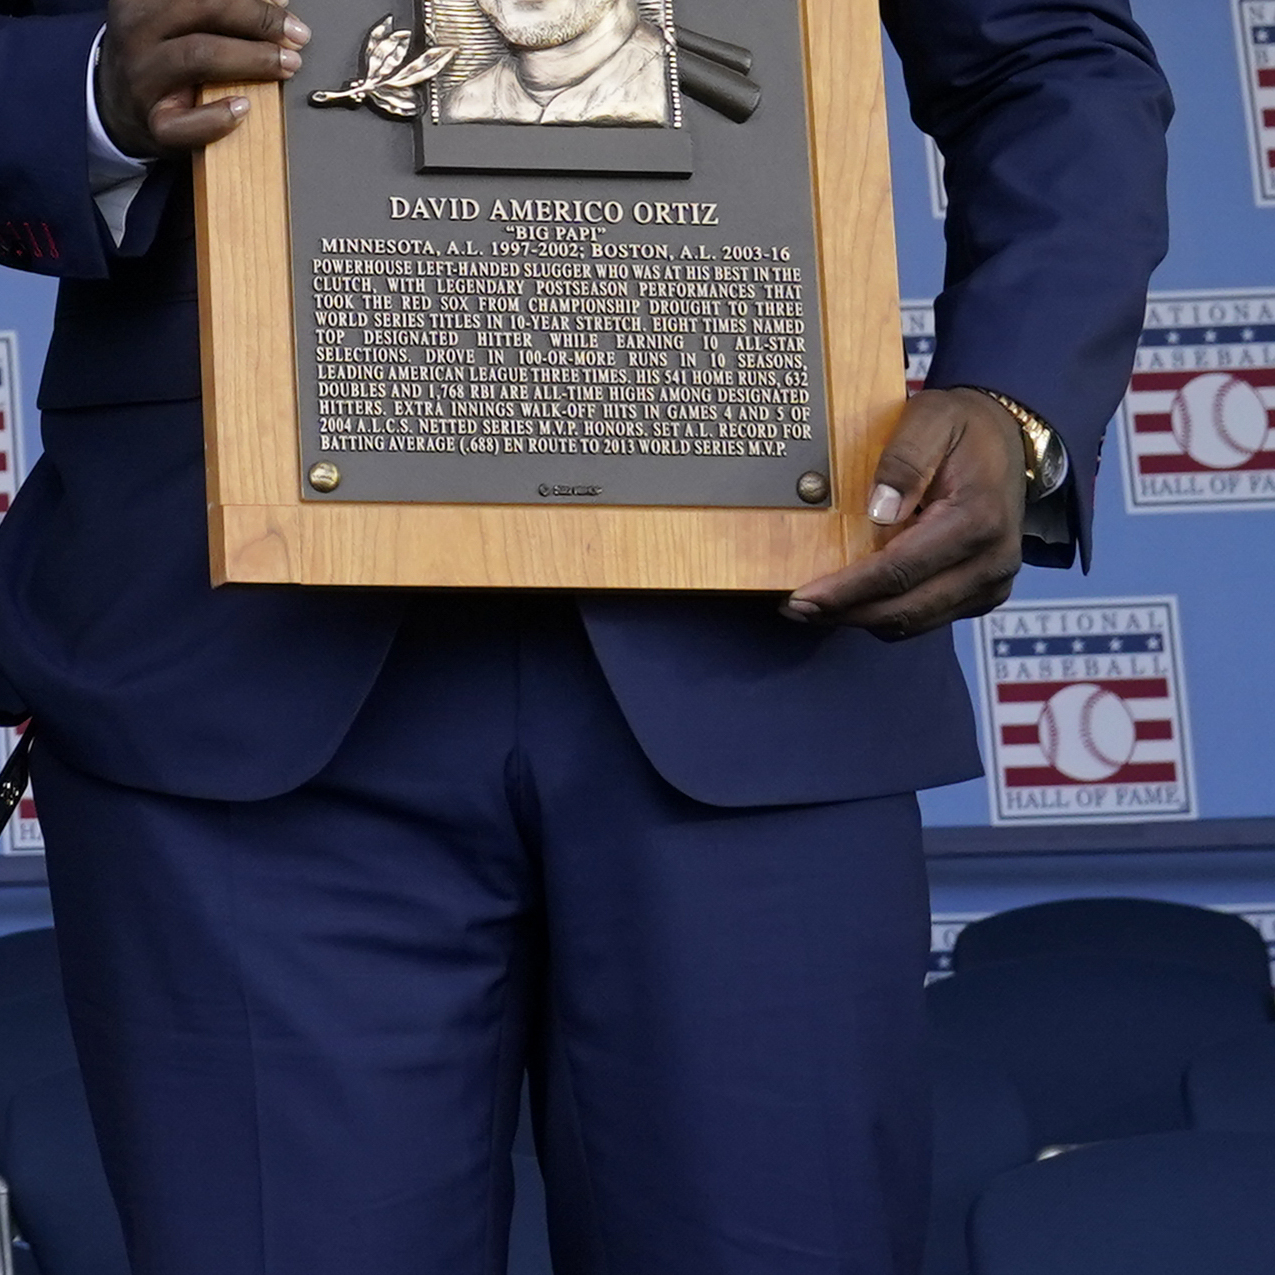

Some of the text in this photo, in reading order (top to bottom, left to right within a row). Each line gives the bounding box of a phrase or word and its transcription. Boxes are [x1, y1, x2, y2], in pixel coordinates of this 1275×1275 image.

[389, 196, 719, 224] DAVID AMERICO ORTIZ
[555, 225, 606, 242] PAPI”
[321, 237, 790, 261] MINNESOTA, A.L. 1997-2002; BOSTON, A.L. 2003-16
[313, 258, 801, 282] POWERHOUSE LEFT-HANDED SLUGGER WHO WAS AT HIS BEST IN THE
[313, 275, 803, 299] CLUTCH, WITH LEGENDARY POSTSEASON PERFORMANCES THAT
[314, 293, 804, 317] TOOK THE RED SOX FROM CHAMPIONSHIP DROUGHT TO THREE
[1141, 476, 1203, 497] HALL
[1210, 474, 1240, 495] OF
[989, 610, 1164, 635] NATIONAL
[995, 656, 1168, 679] BASEBALL
[1006, 785, 1180, 810] HALL OF FAME
